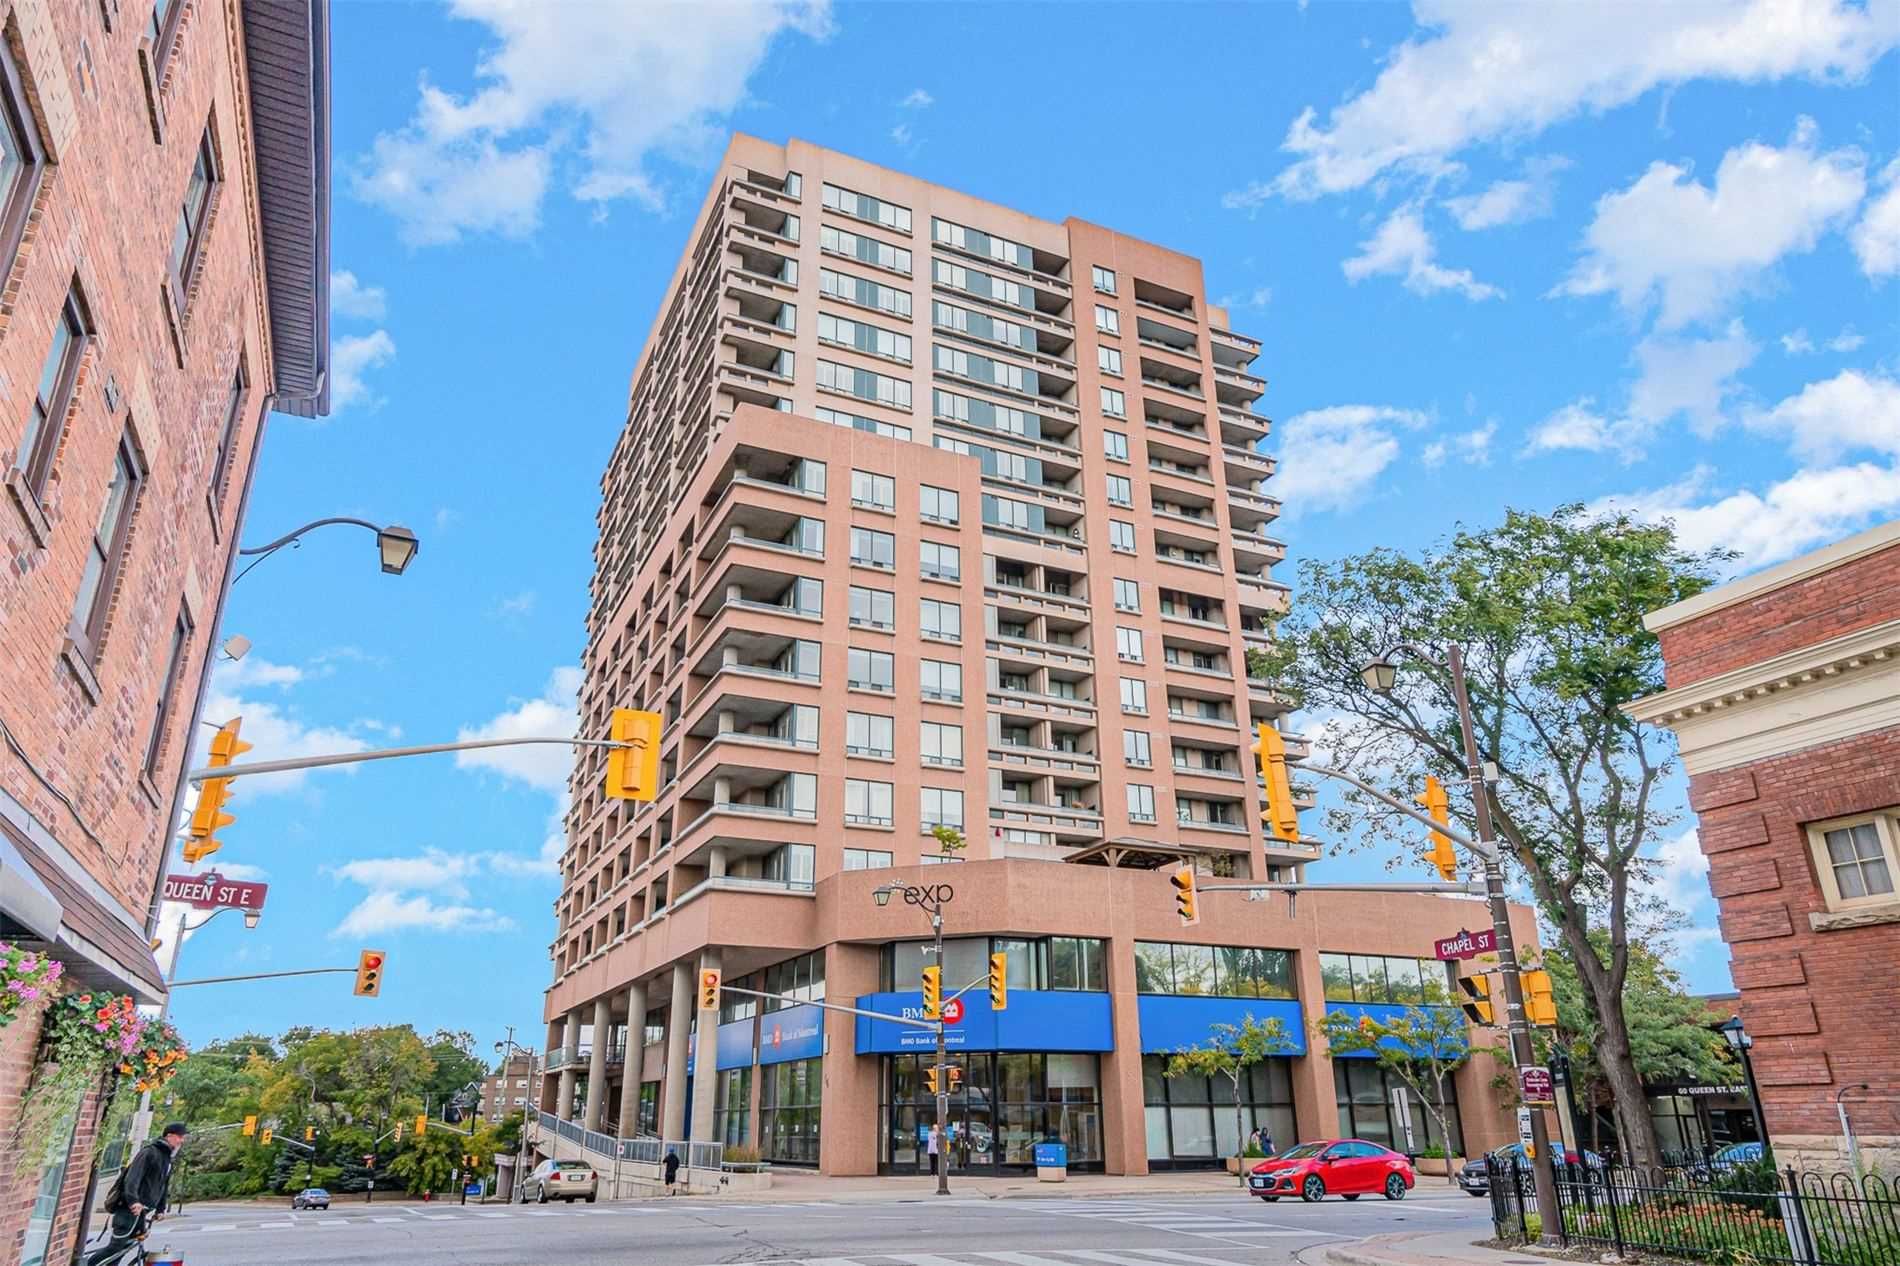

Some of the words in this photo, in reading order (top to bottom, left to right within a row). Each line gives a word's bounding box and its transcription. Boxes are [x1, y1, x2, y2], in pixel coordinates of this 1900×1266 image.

[163, 881, 214, 901] QUEEN
[217, 886, 238, 904] ST
[240, 888, 252, 905] E
[904, 884, 954, 905] exp
[1442, 939, 1475, 955] CHAPEL
[1478, 935, 1489, 948] ST
[902, 1007, 925, 1019] BM
[915, 1036, 930, 1045] Bank
[944, 1035, 965, 1044] ontreal
[1688, 1086, 1715, 1095] QUEEN
[1716, 1085, 1729, 1094] ST.
